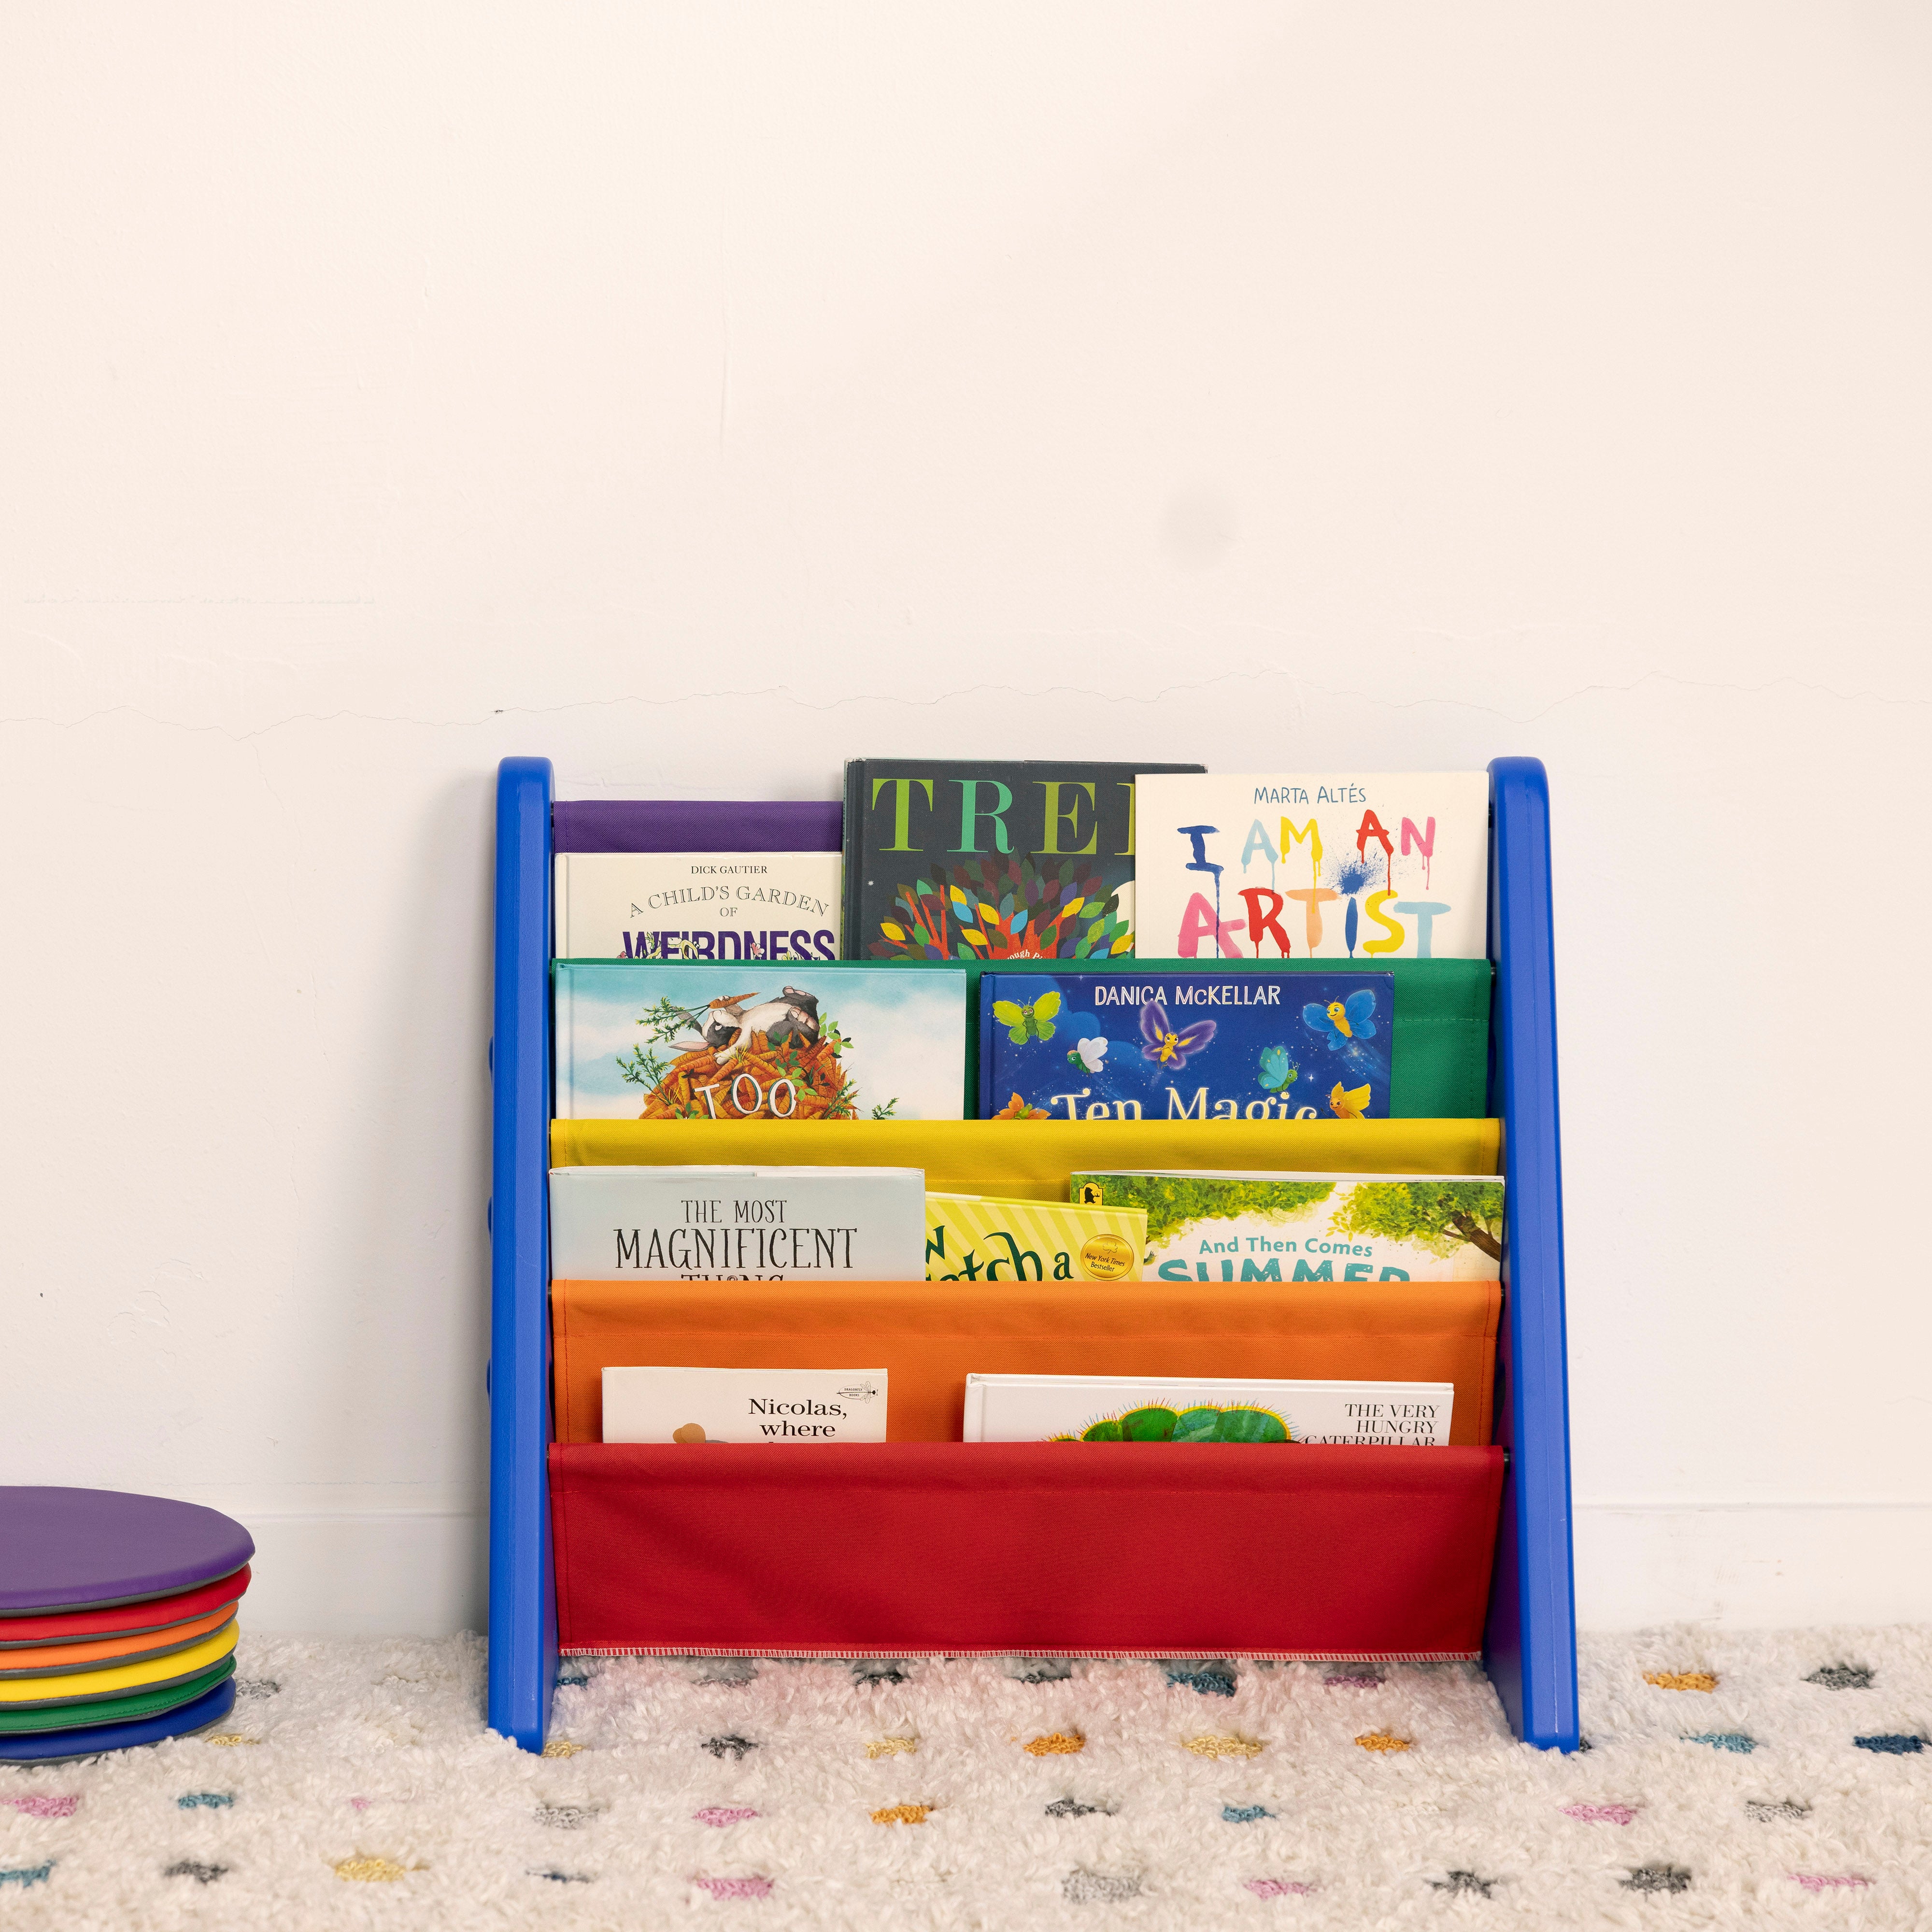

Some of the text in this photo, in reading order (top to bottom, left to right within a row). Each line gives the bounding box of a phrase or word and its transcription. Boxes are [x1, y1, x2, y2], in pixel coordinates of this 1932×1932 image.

[1254, 783, 1366, 805] MARTA ALTÉS
[1177, 809, 1436, 877] I AM AN
[691, 866, 768, 874] DICK GAUTIER
[629, 885, 830, 918] A CHILD'S GARDEN
[719, 907, 738, 917] OF
[1177, 887, 1452, 958] ARTIST
[622, 929, 836, 960] WEIRDNESS
[1095, 985, 1281, 1006] DANICA McKELLAR
[693, 1073, 797, 1120] TOO
[1051, 1088, 1142, 1120] Ten
[681, 1199, 787, 1223] THE MOST
[613, 1228, 857, 1270] MAGNIFICENT
[1199, 1236, 1373, 1257] And Then Comes
[1053, 1252, 1075, 1280] a
[1091, 1261, 1115, 1272] Bestseller
[1110, 1258, 1126, 1266] Times
[748, 1398, 847, 1419] Nicolas,
[1345, 1404, 1440, 1418] THE VERY
[759, 1421, 836, 1437] where
[1356, 1420, 1438, 1434] HUNGRY
[1306, 1435, 1435, 1446] CATERPILLAR
